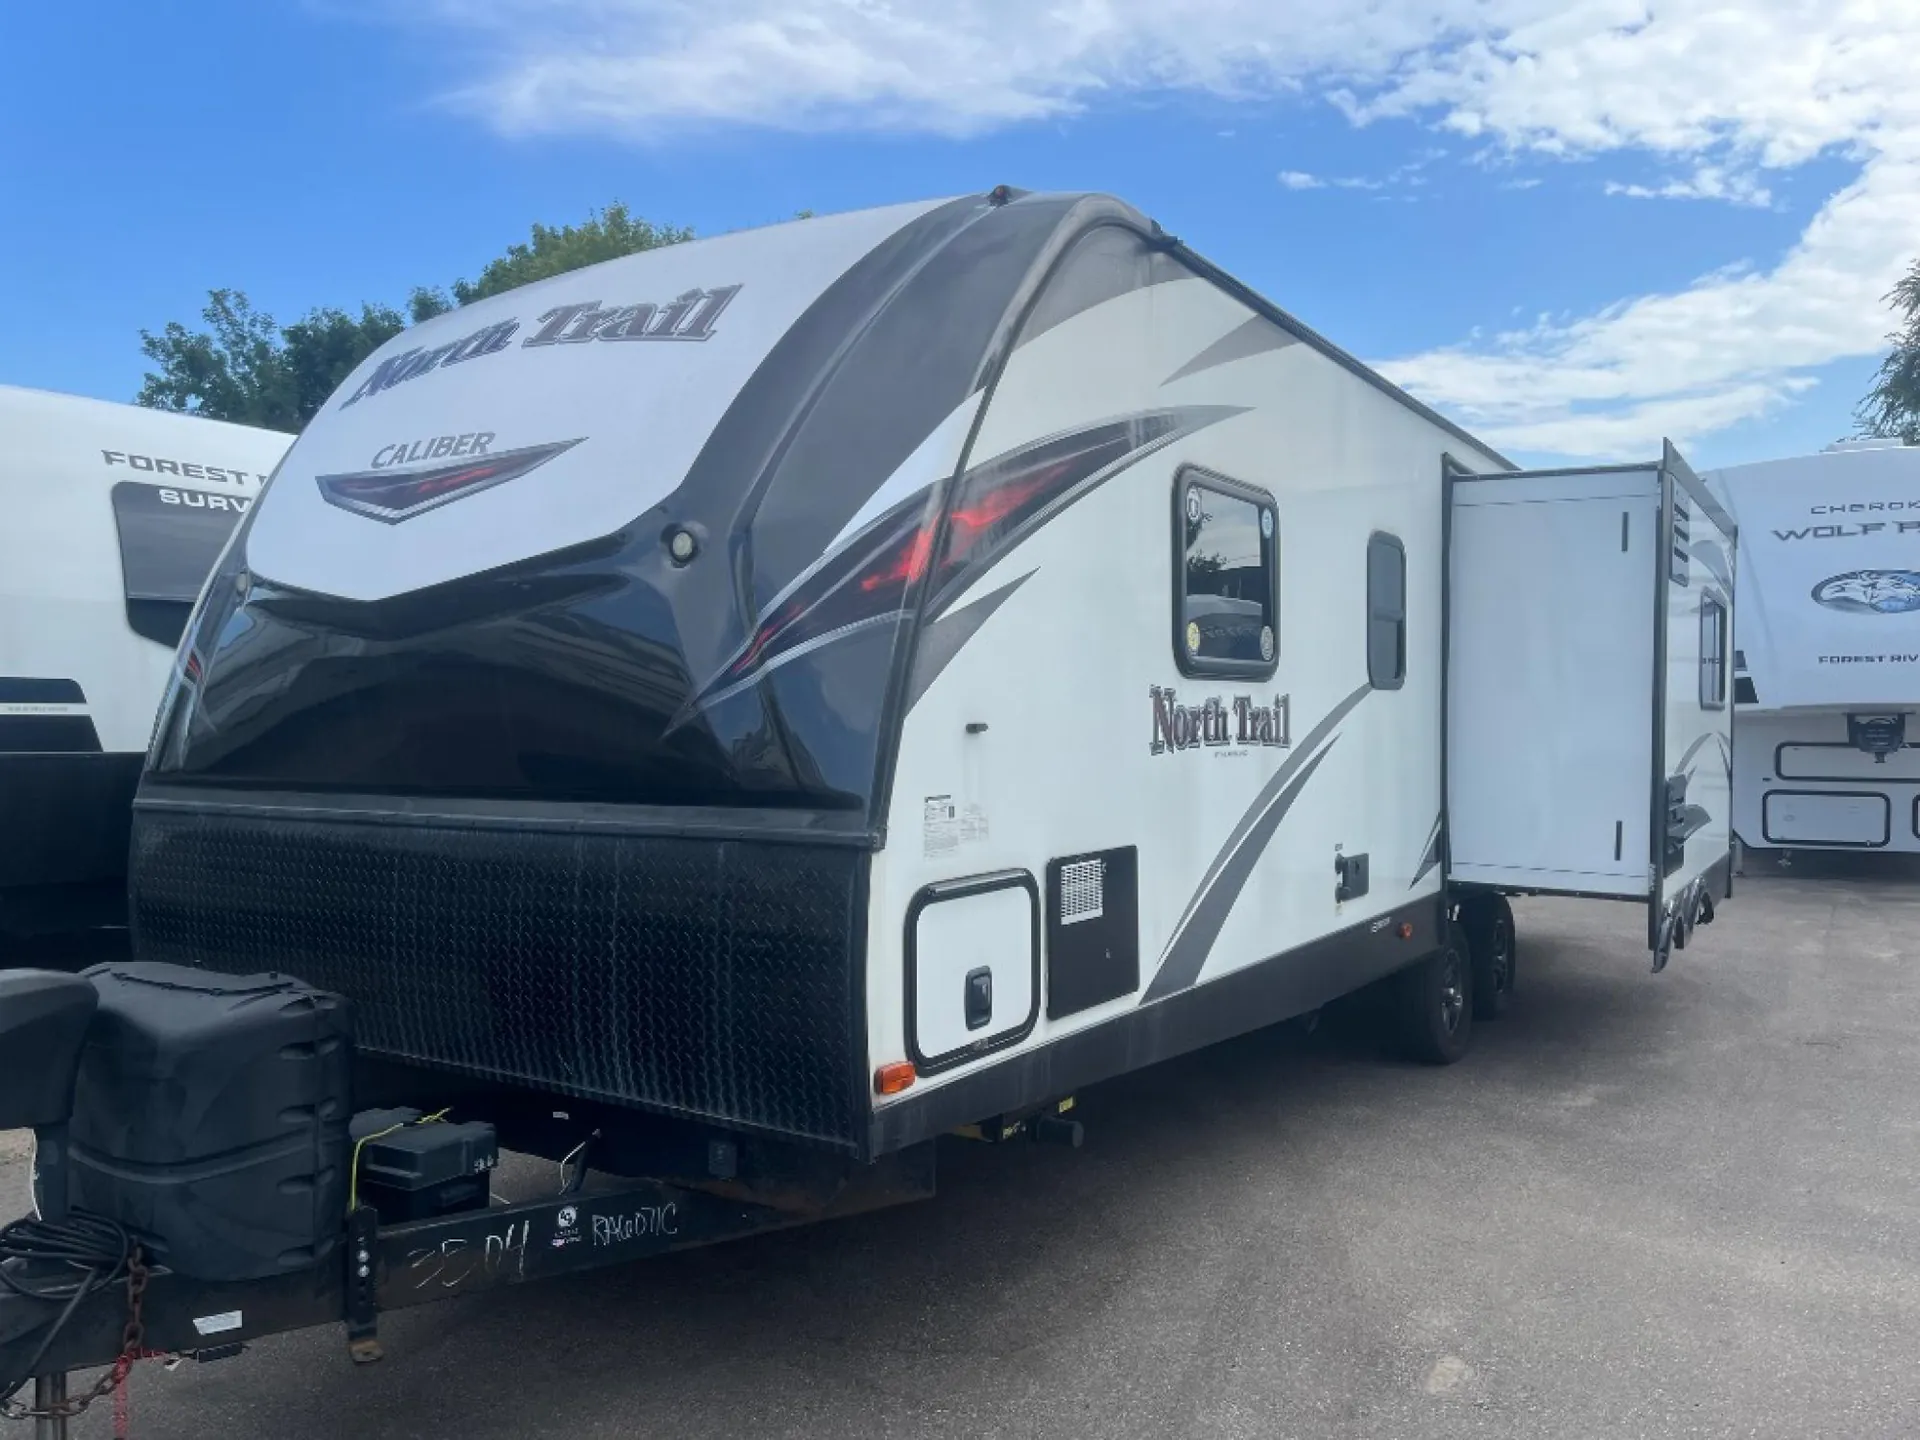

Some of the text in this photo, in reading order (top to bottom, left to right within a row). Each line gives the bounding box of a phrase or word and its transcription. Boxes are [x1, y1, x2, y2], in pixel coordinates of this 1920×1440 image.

[521, 283, 745, 349] Trail
[100, 449, 250, 486] FOREST
[370, 432, 496, 469] CALIBER
[1770, 522, 1887, 541] WOLF
[1817, 655, 1886, 664] FOREST
[1149, 684, 1293, 756] North Trail
